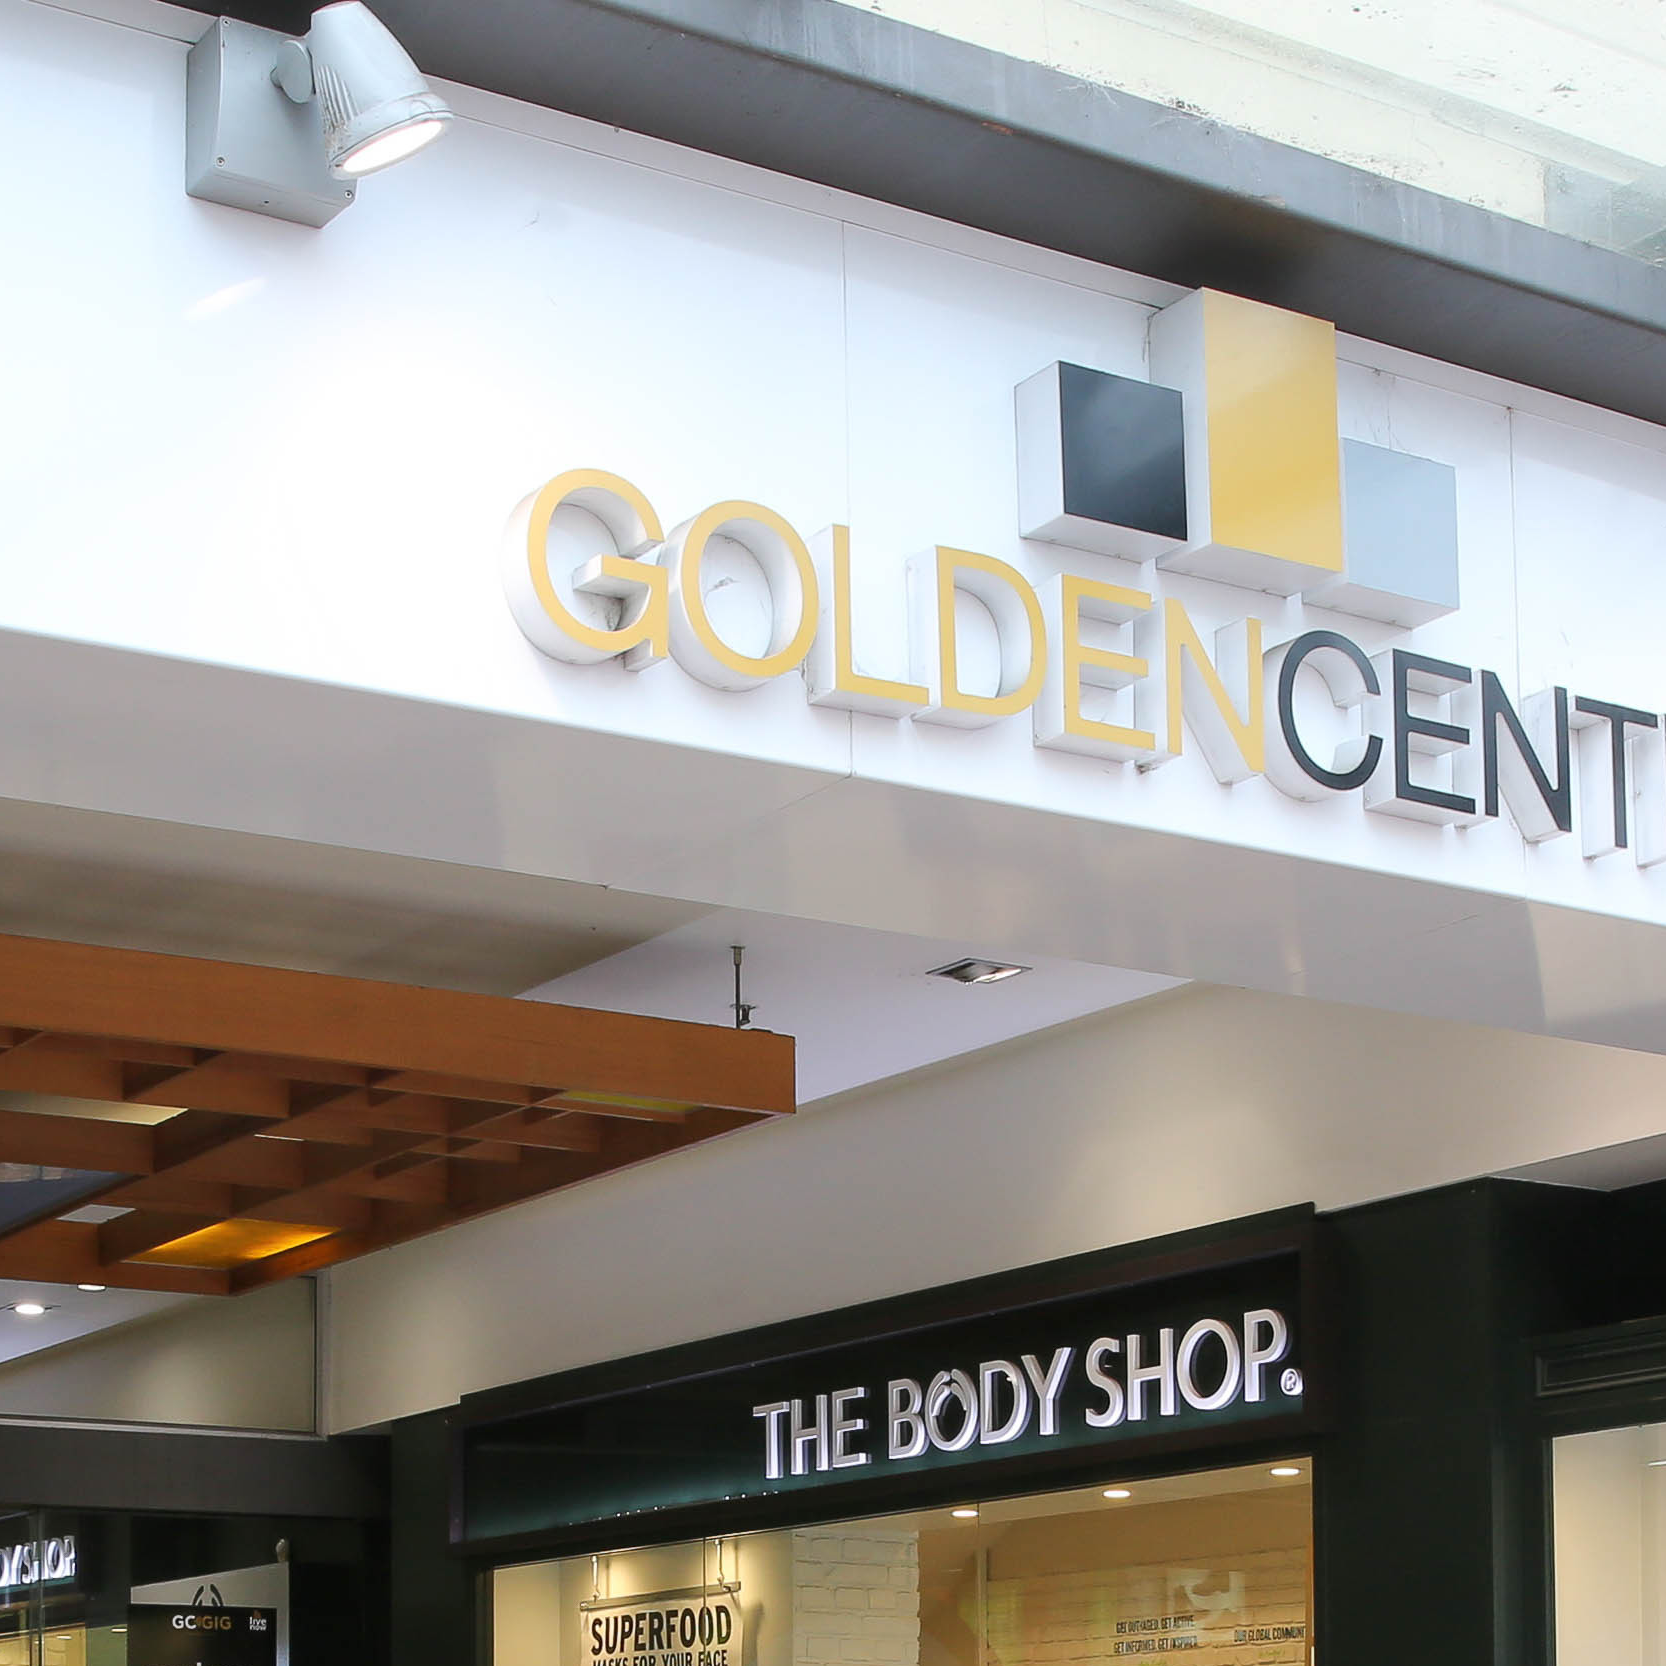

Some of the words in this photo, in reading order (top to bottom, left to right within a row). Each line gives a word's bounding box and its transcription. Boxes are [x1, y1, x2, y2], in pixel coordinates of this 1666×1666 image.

[752, 1386, 872, 1480] THE
[887, 1346, 1076, 1461] BODY
[591, 1604, 732, 1656] SUPERFOOD
